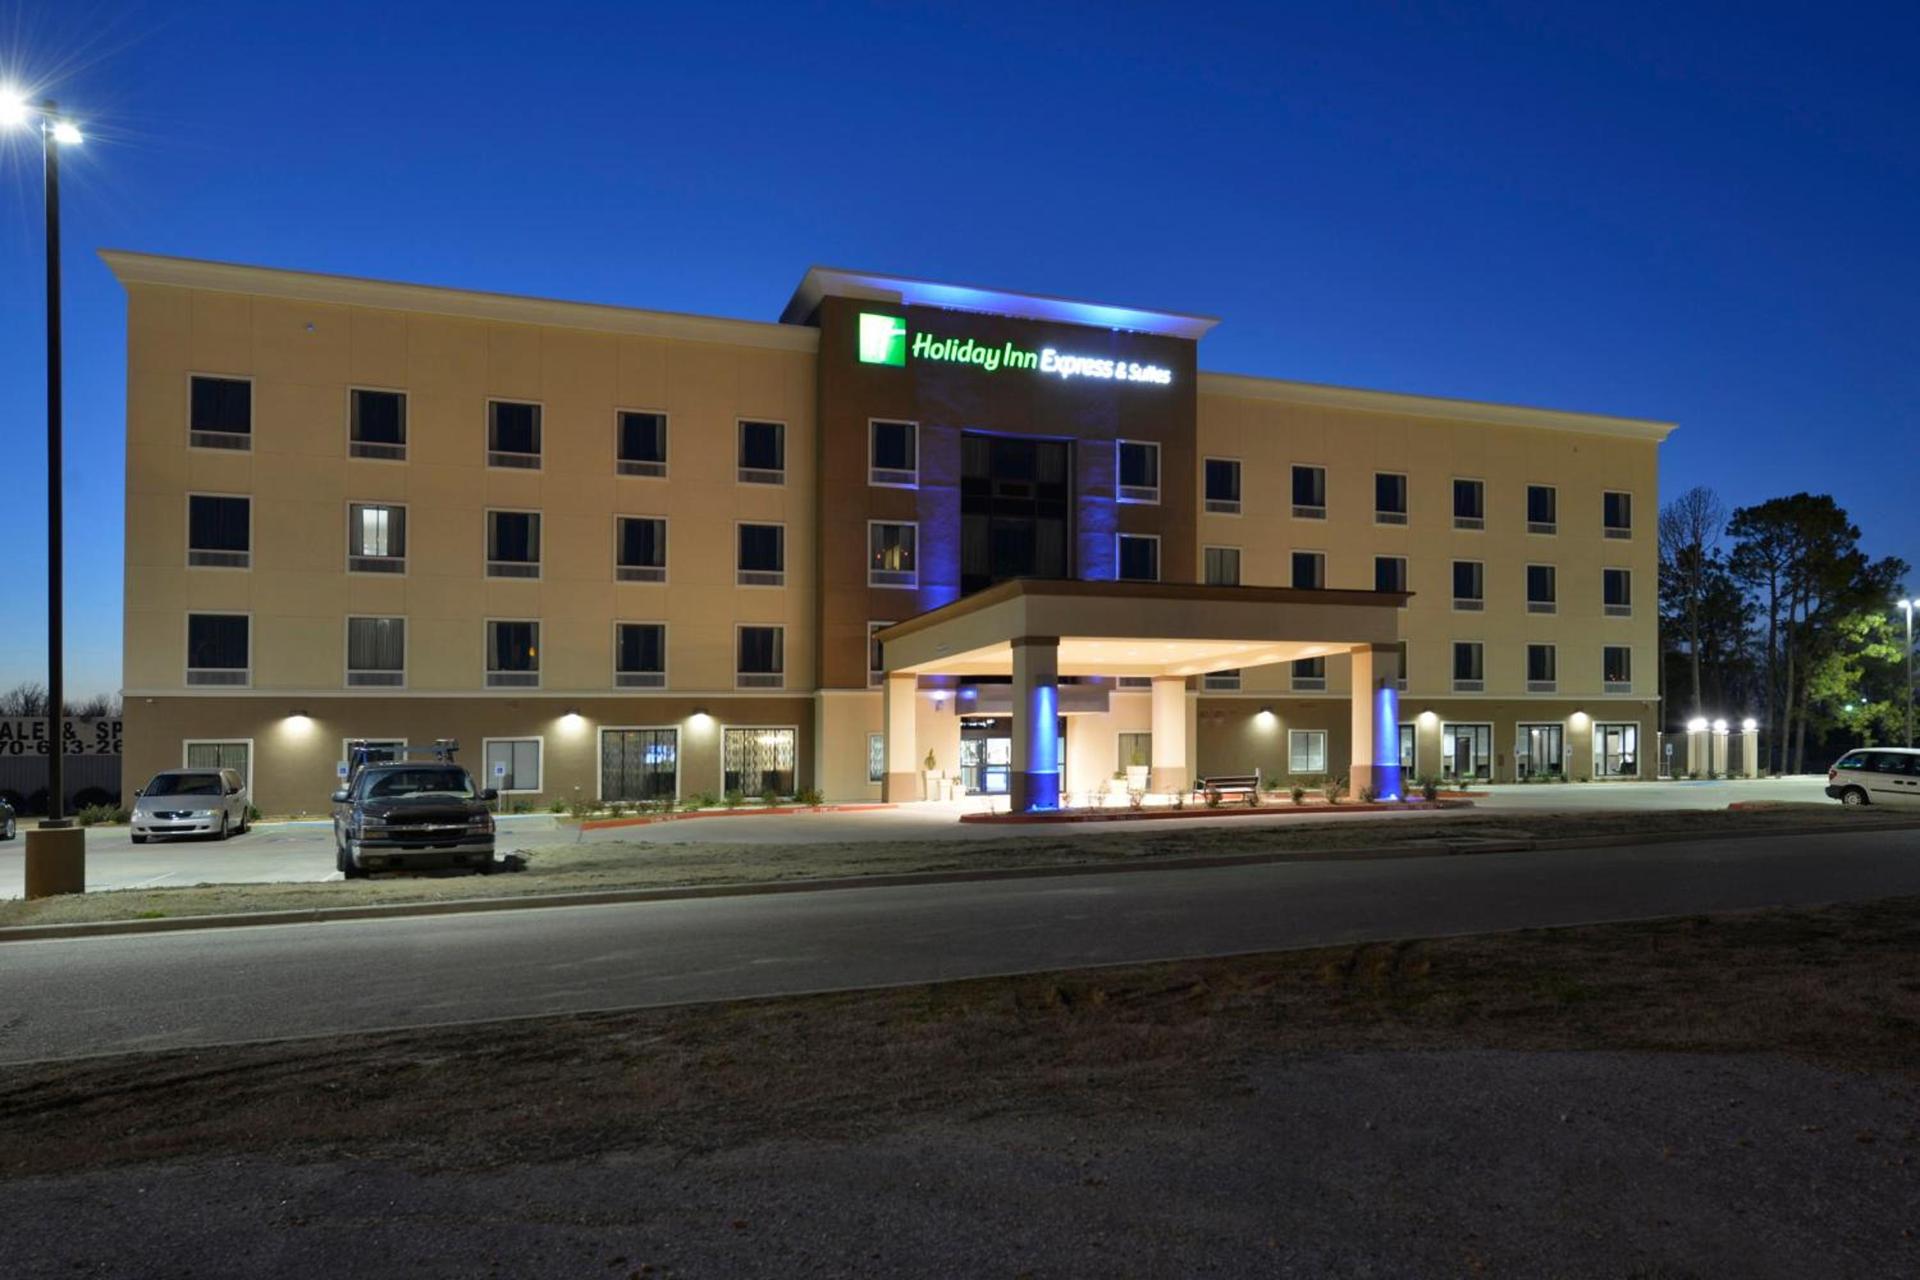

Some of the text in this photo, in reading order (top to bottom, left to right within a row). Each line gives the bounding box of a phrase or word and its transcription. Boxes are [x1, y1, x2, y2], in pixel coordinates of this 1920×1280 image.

[912, 332, 1171, 384] Holiday Inn Express & Suites
[0, 721, 122, 740] ALE & SP
